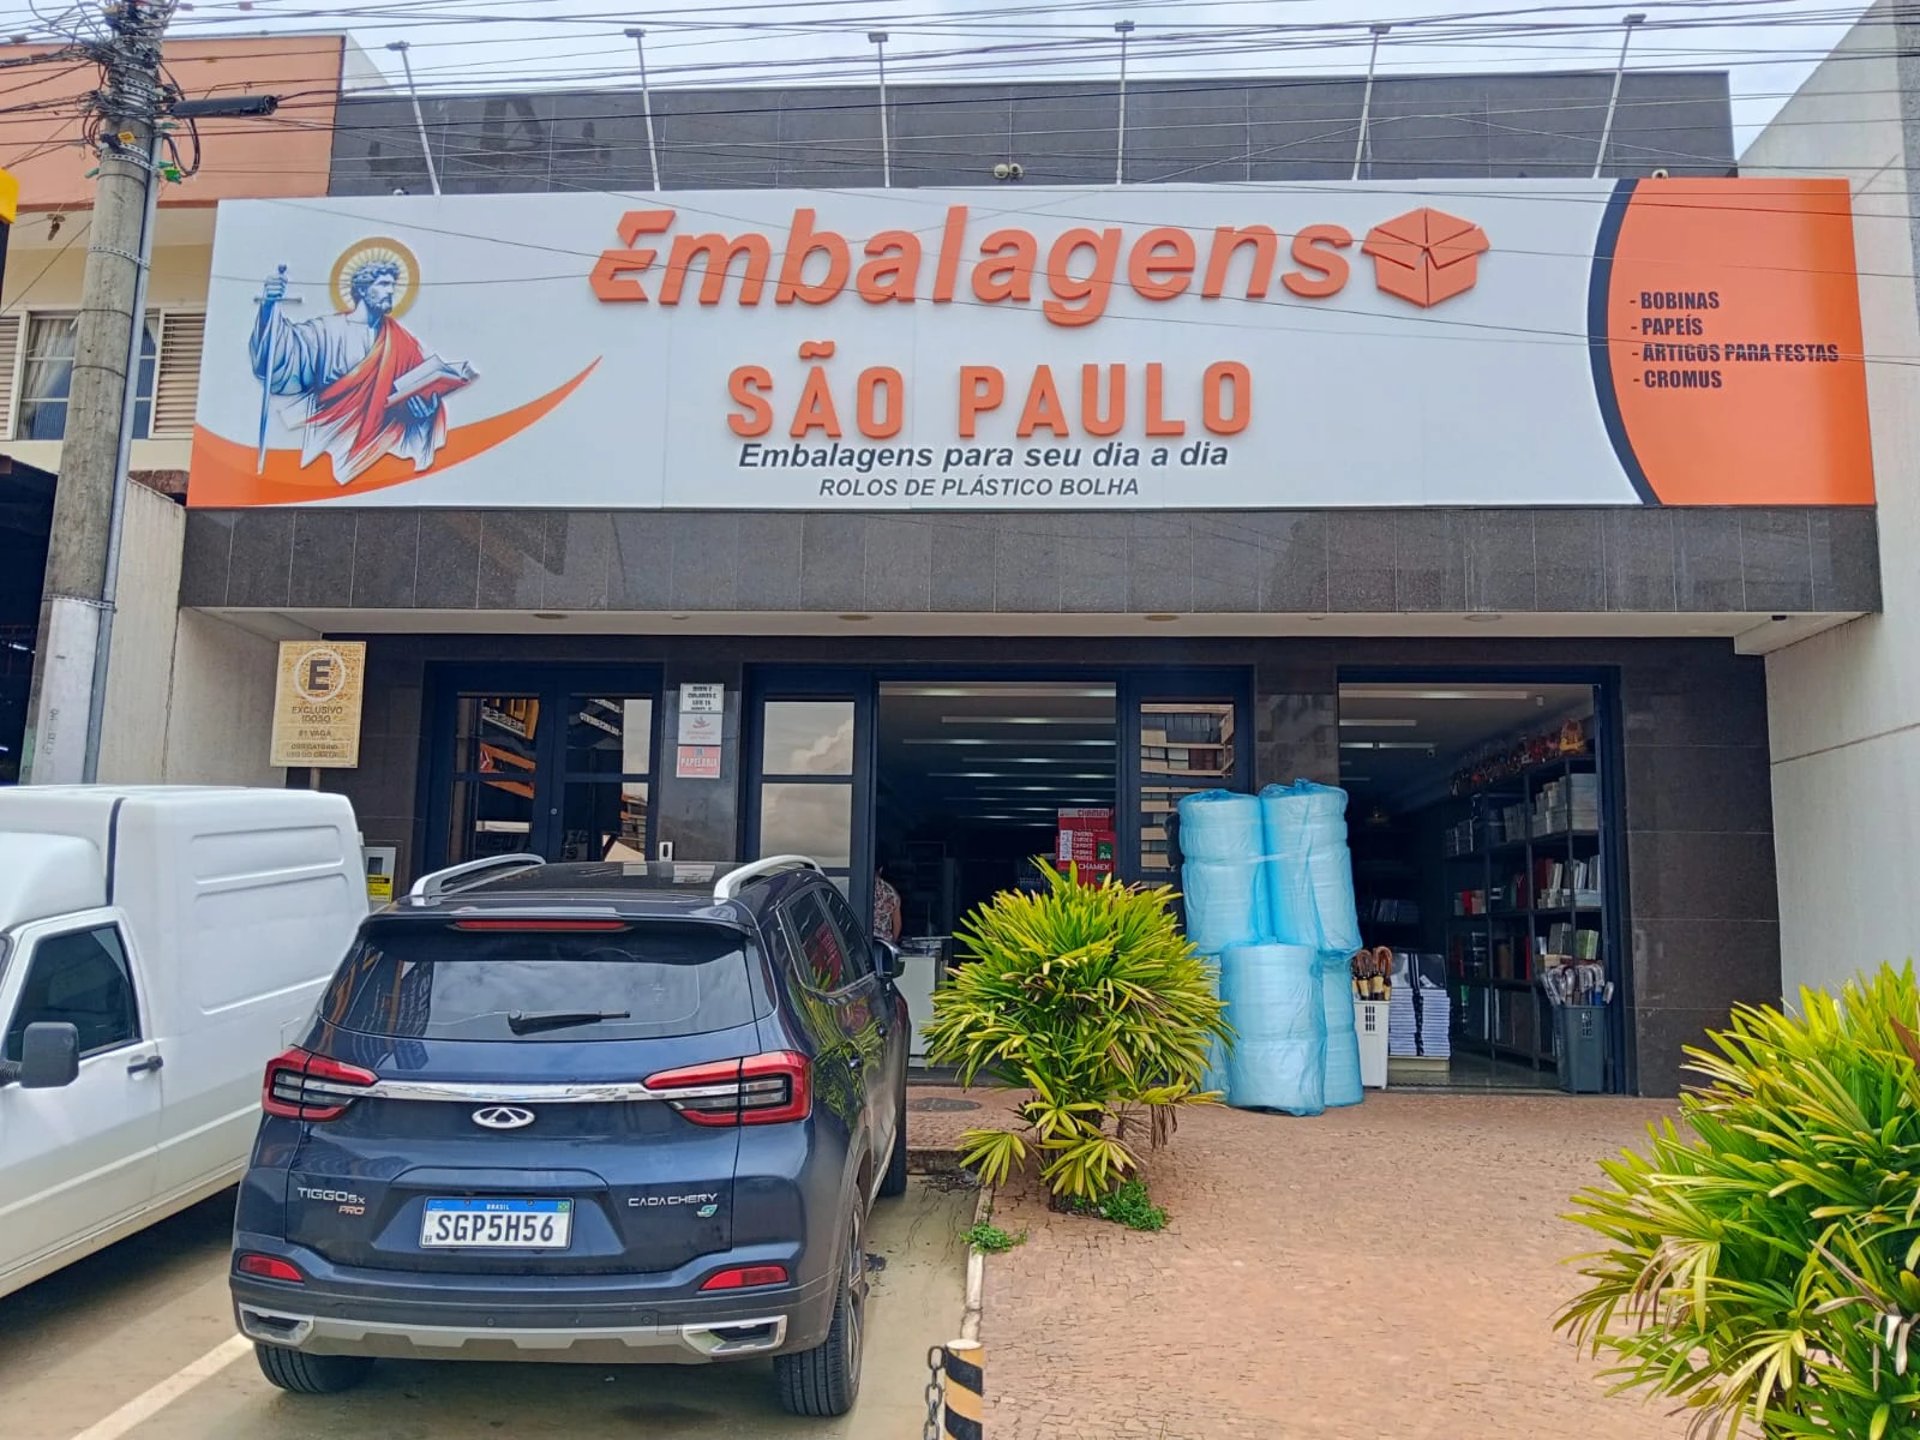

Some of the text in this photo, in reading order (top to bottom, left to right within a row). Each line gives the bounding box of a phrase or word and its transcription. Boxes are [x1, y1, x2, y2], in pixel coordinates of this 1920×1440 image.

[588, 205, 1353, 328] Embalagens
[1640, 291, 1720, 309] BOBINAS
[1641, 314, 1703, 336] PAPEÍS
[1642, 343, 1721, 363] ARTIGOS
[1724, 343, 1772, 363] PARA
[1775, 343, 1840, 363] FESTAS
[726, 340, 1252, 439] SÃO PAULO
[1644, 370, 1723, 389] CROMUS
[738, 441, 1230, 473] Embalagens para seu dia a dia
[819, 474, 1140, 497] ROLOS DE PLÁSTICO BOLHA
[307, 659, 332, 691] E
[291, 705, 343, 715] EXCLUSIVO
[338, 1205, 366, 1216] PRO
[485, 1203, 510, 1211] BRASIL
[435, 1213, 554, 1242] SGP5H56
